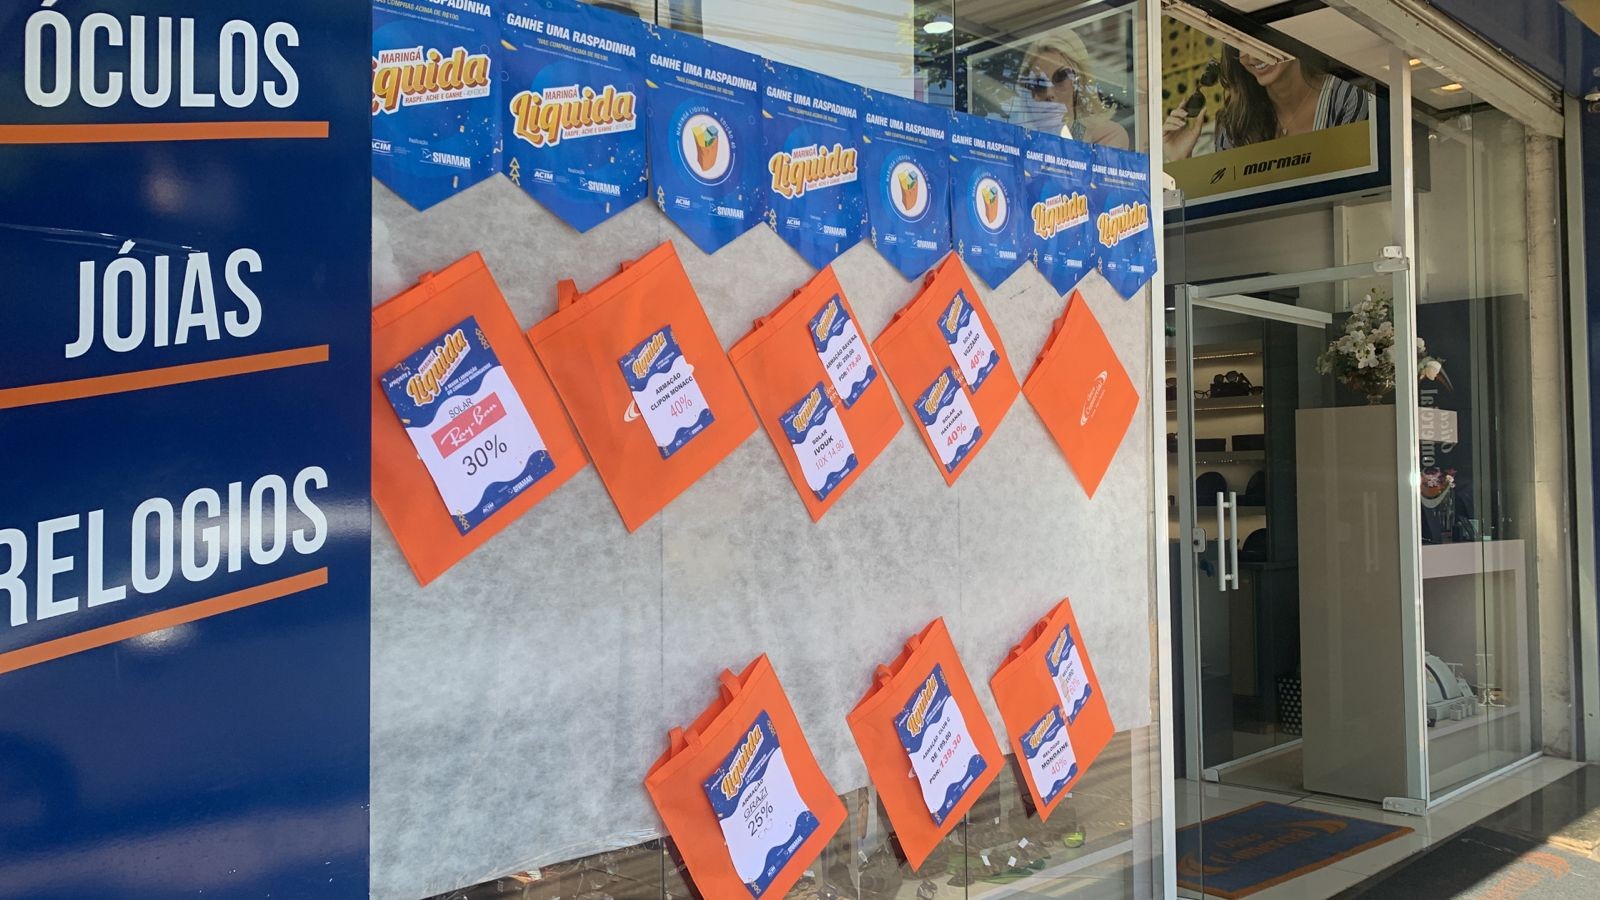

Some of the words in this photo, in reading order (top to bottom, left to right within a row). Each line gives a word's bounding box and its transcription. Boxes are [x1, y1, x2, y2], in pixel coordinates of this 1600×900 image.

[507, 13, 544, 33] GANHE
[546, 23, 570, 40] UMA
[572, 30, 636, 58] RASPADINHA
[24, 0, 299, 108] ÓCULOS
[381, 49, 421, 64] MARINGÁ
[650, 53, 681, 71] GANHE
[683, 62, 702, 78] UMA
[704, 68, 757, 92] RASPADINHA
[545, 87, 578, 100] MARINGÁ
[766, 86, 792, 102] GANHE
[793, 93, 811, 107] UMA
[812, 98, 857, 119] RASPADINHA
[866, 113, 888, 127] GANHE
[889, 118, 904, 131] UMA
[905, 122, 945, 140] RASPADINHA
[952, 134, 973, 146] GANHE
[973, 138, 986, 149] UMA
[987, 141, 1020, 156] RASPADINHA
[432, 152, 471, 168] SIVAMAR
[1243, 152, 1312, 176] mormaii
[534, 171, 554, 181] ACIM
[587, 181, 621, 196] SIVAMAR
[717, 206, 744, 219] SIVAMAR
[65, 239, 263, 358] JÓIAS
[970, 347, 985, 370] 40%
[655, 372, 681, 395] ARMAÇÃO
[449, 397, 474, 418] SOLAR
[650, 393, 671, 411] CLIPON
[670, 394, 693, 417] 40%
[440, 403, 497, 447] Ray-Ban
[942, 408, 956, 424] SOLAR
[813, 435, 834, 456] IVOUK
[947, 422, 967, 446] 40%
[462, 434, 508, 476] 30%
[815, 457, 829, 471] 10X
[0, 466, 329, 627] RELOGIOS
[930, 754, 938, 763] DE
[940, 734, 962, 769] 139,30
[1041, 741, 1069, 769] MONDAINE
[1051, 757, 1067, 775] 40%
[748, 801, 773, 836] 25%
